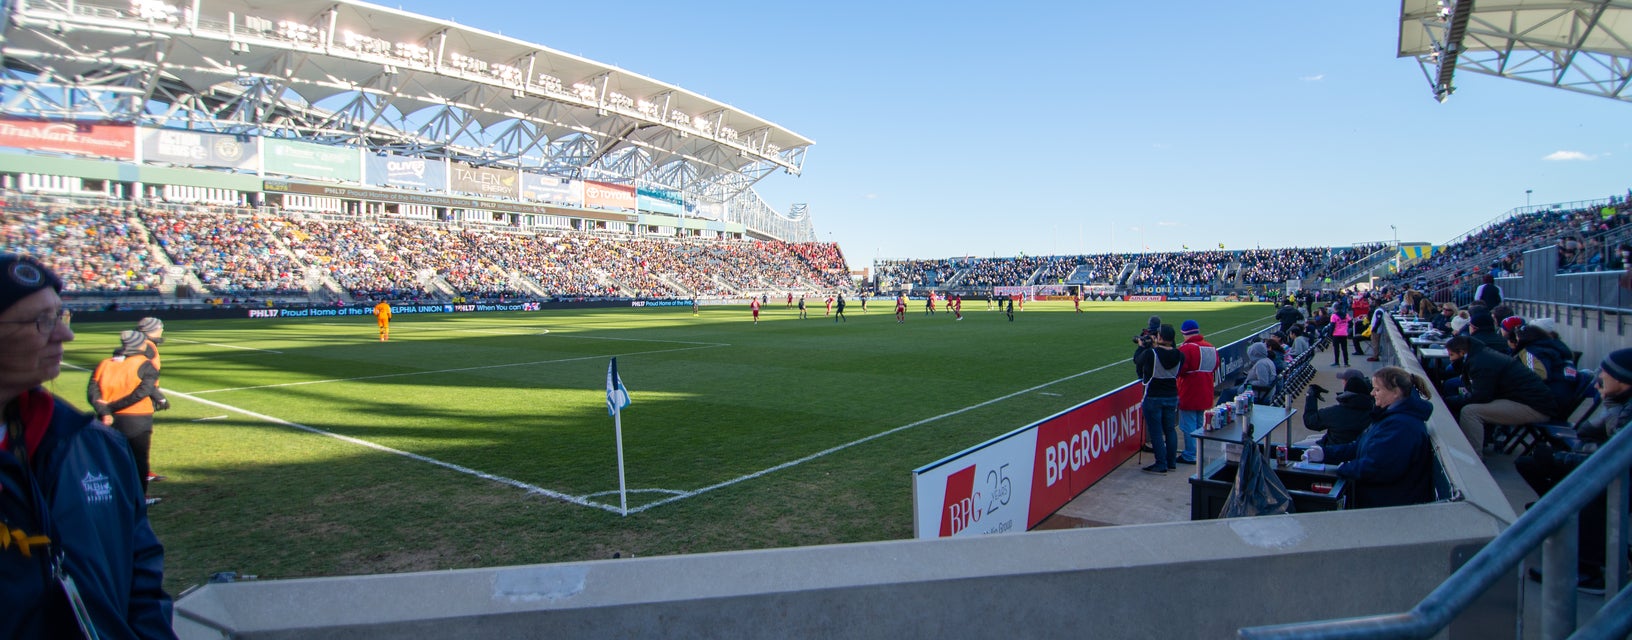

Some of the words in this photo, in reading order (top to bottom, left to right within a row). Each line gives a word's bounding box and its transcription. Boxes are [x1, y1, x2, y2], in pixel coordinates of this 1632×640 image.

[0, 123, 79, 142] TruMark
[456, 168, 500, 185] TALEN
[481, 184, 513, 194] ENERGY
[249, 309, 279, 318] PHL17
[281, 309, 308, 317] Proud
[310, 308, 337, 316] Home
[348, 307, 362, 315] the
[364, 305, 416, 315] PHELPHIA
[418, 305, 442, 313] UNION
[1045, 404, 1142, 488] BPGROUP.NET
[986, 463, 1012, 515] 25
[949, 491, 983, 535] BPG
